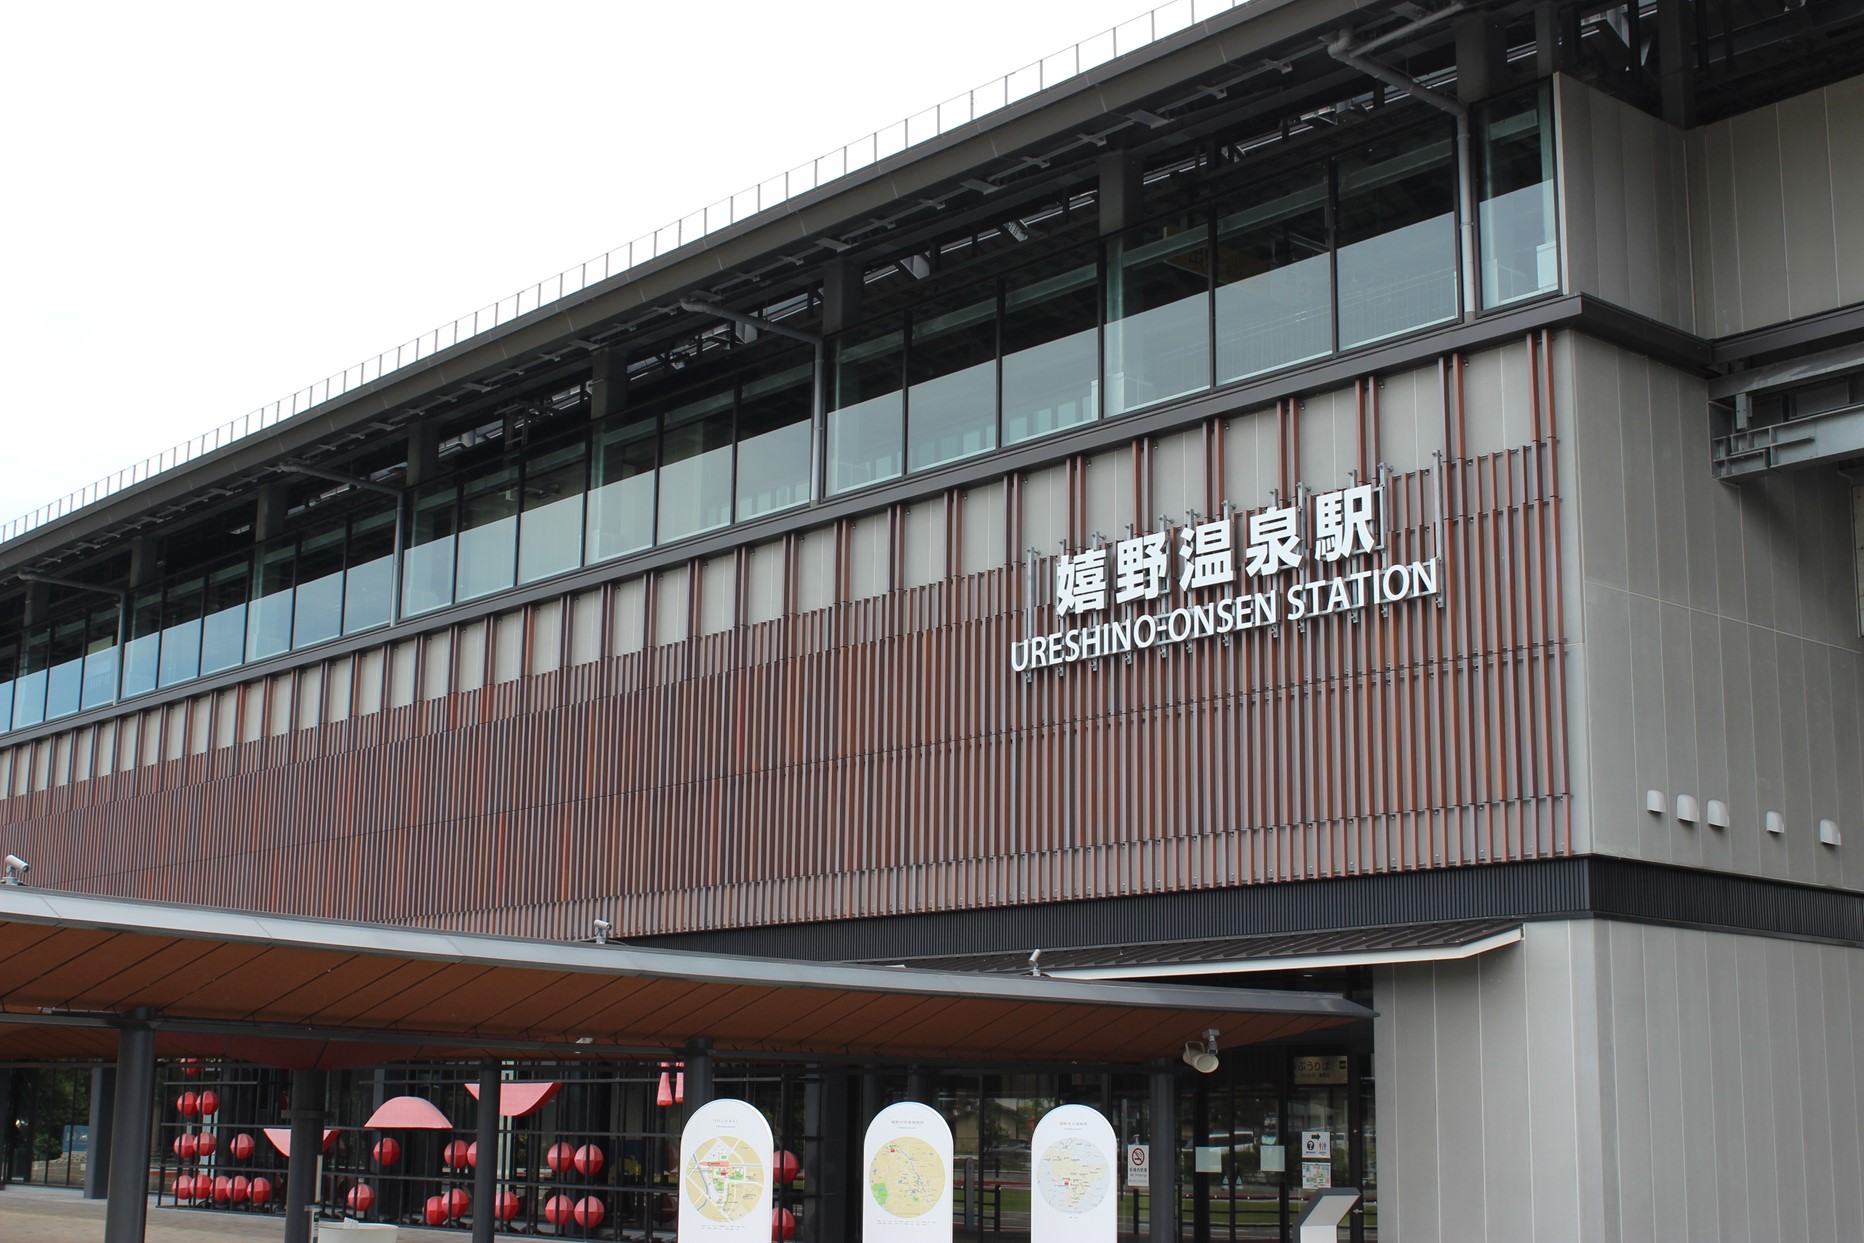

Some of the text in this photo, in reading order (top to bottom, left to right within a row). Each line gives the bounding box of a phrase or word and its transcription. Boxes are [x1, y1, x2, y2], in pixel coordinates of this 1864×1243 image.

[1057, 484, 1375, 616] 嬉野温泉駅
[1010, 558, 1437, 672] URESHINO-ONSEN STATION
